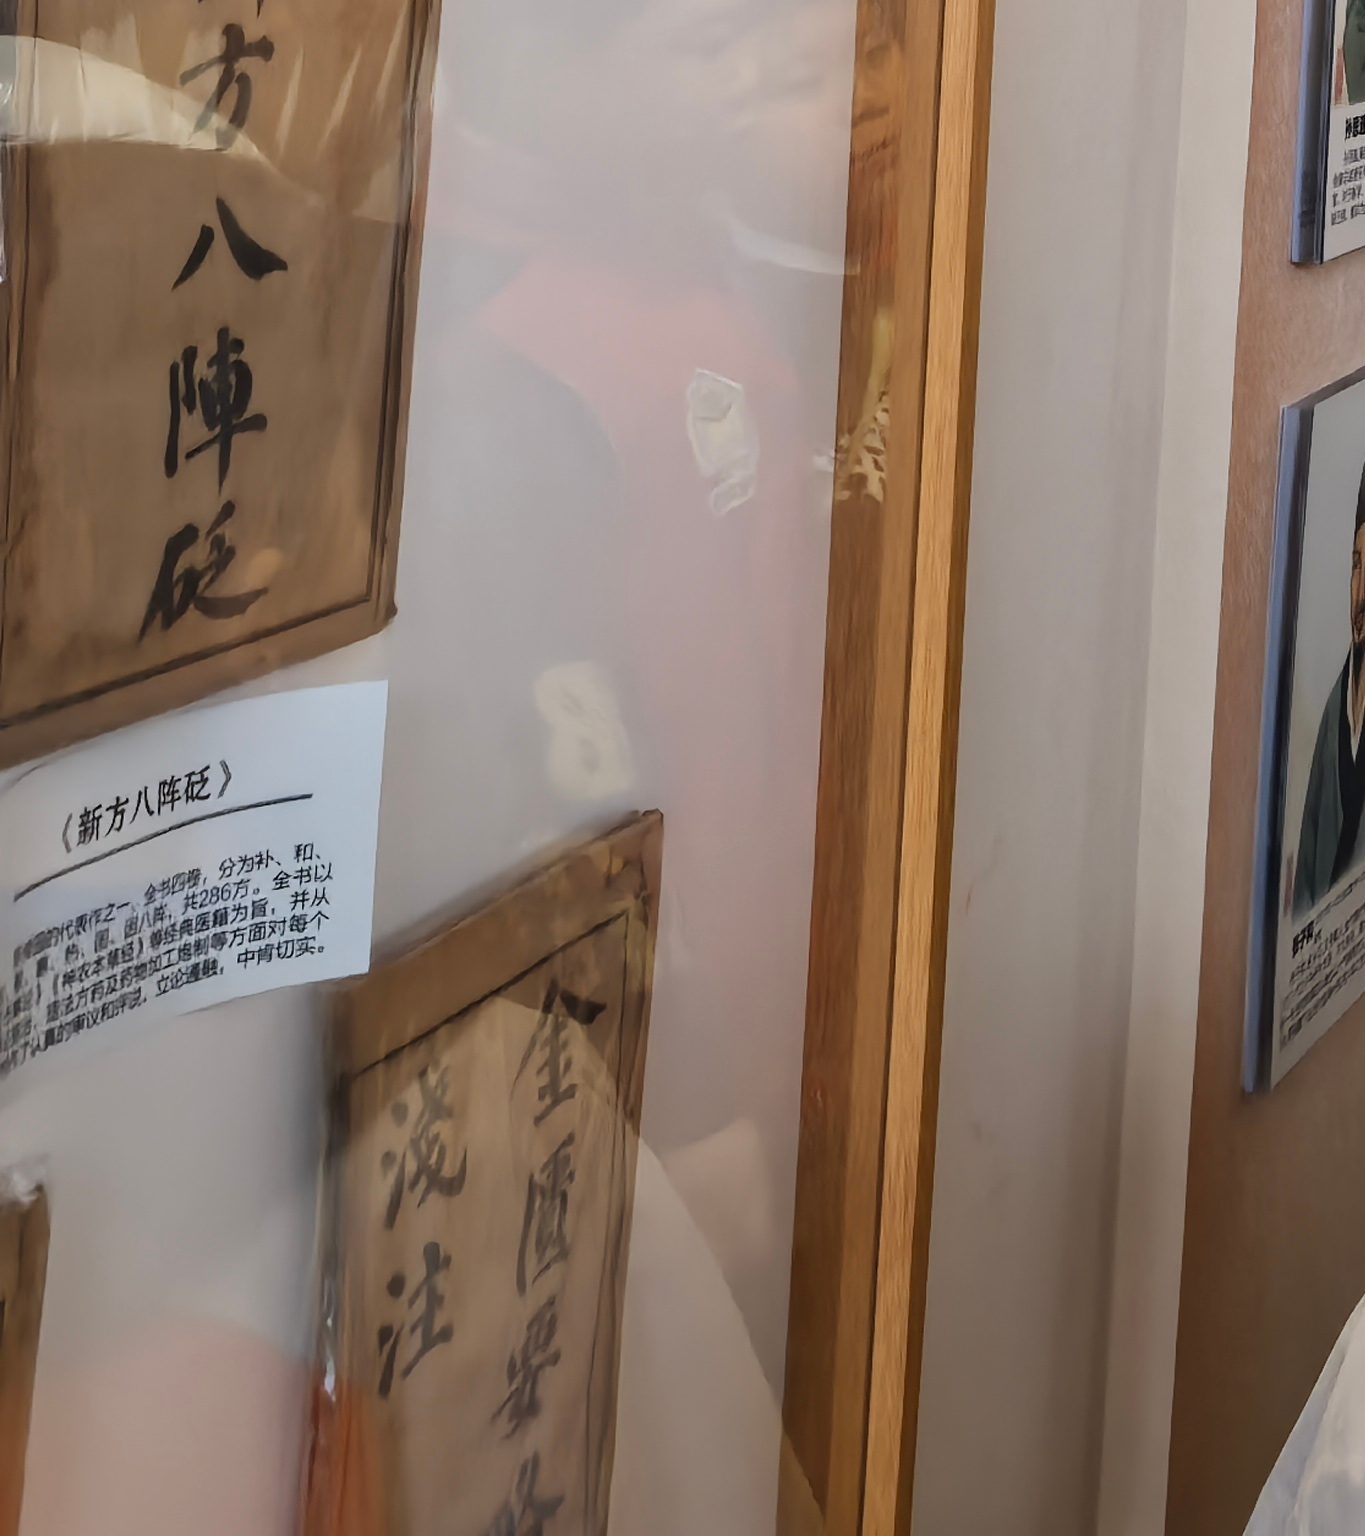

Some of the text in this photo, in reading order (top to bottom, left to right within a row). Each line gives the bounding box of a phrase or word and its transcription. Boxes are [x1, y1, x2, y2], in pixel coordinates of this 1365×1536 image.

[61, 759, 233, 854] 《新方八阵砭》
